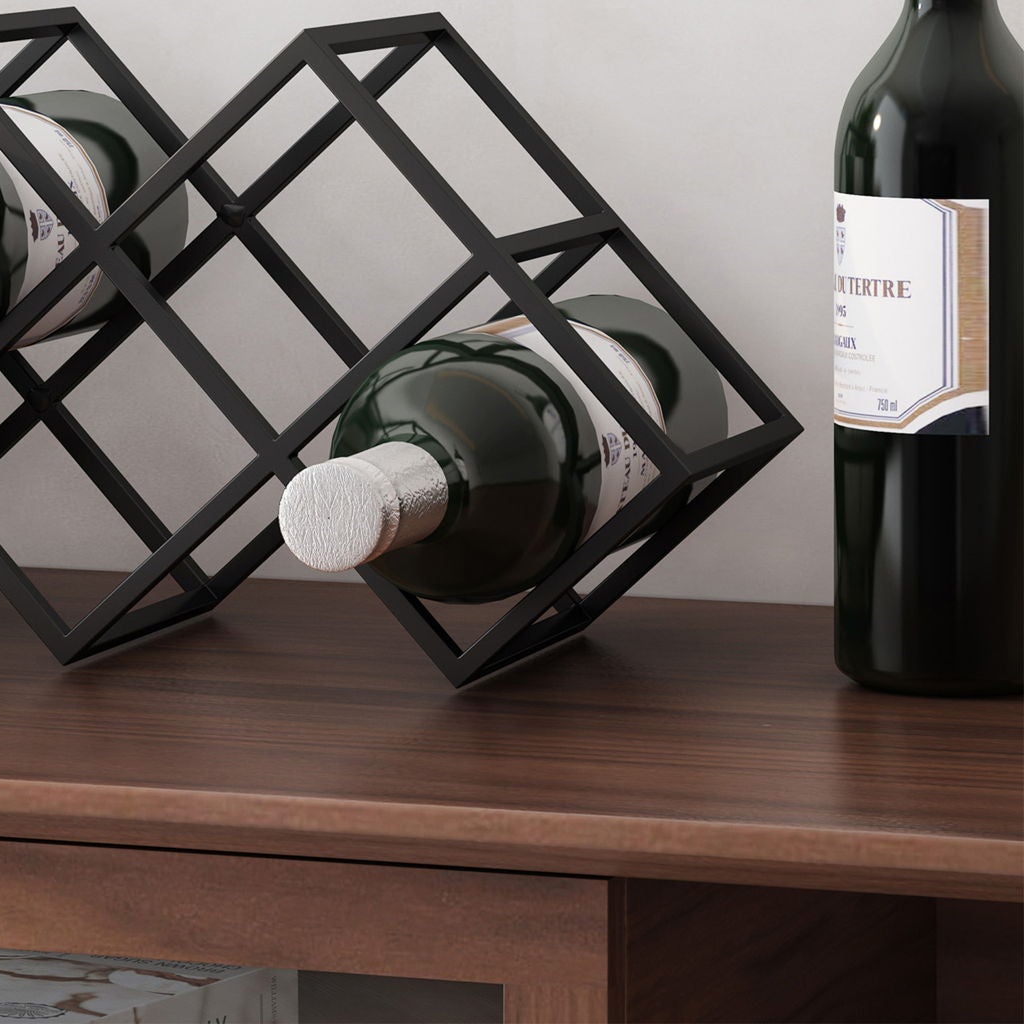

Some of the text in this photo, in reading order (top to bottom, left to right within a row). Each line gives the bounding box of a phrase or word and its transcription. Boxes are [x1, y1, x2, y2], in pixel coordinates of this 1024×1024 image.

[848, 276, 912, 299] TERTRE
[877, 398, 898, 412] 750 ml
